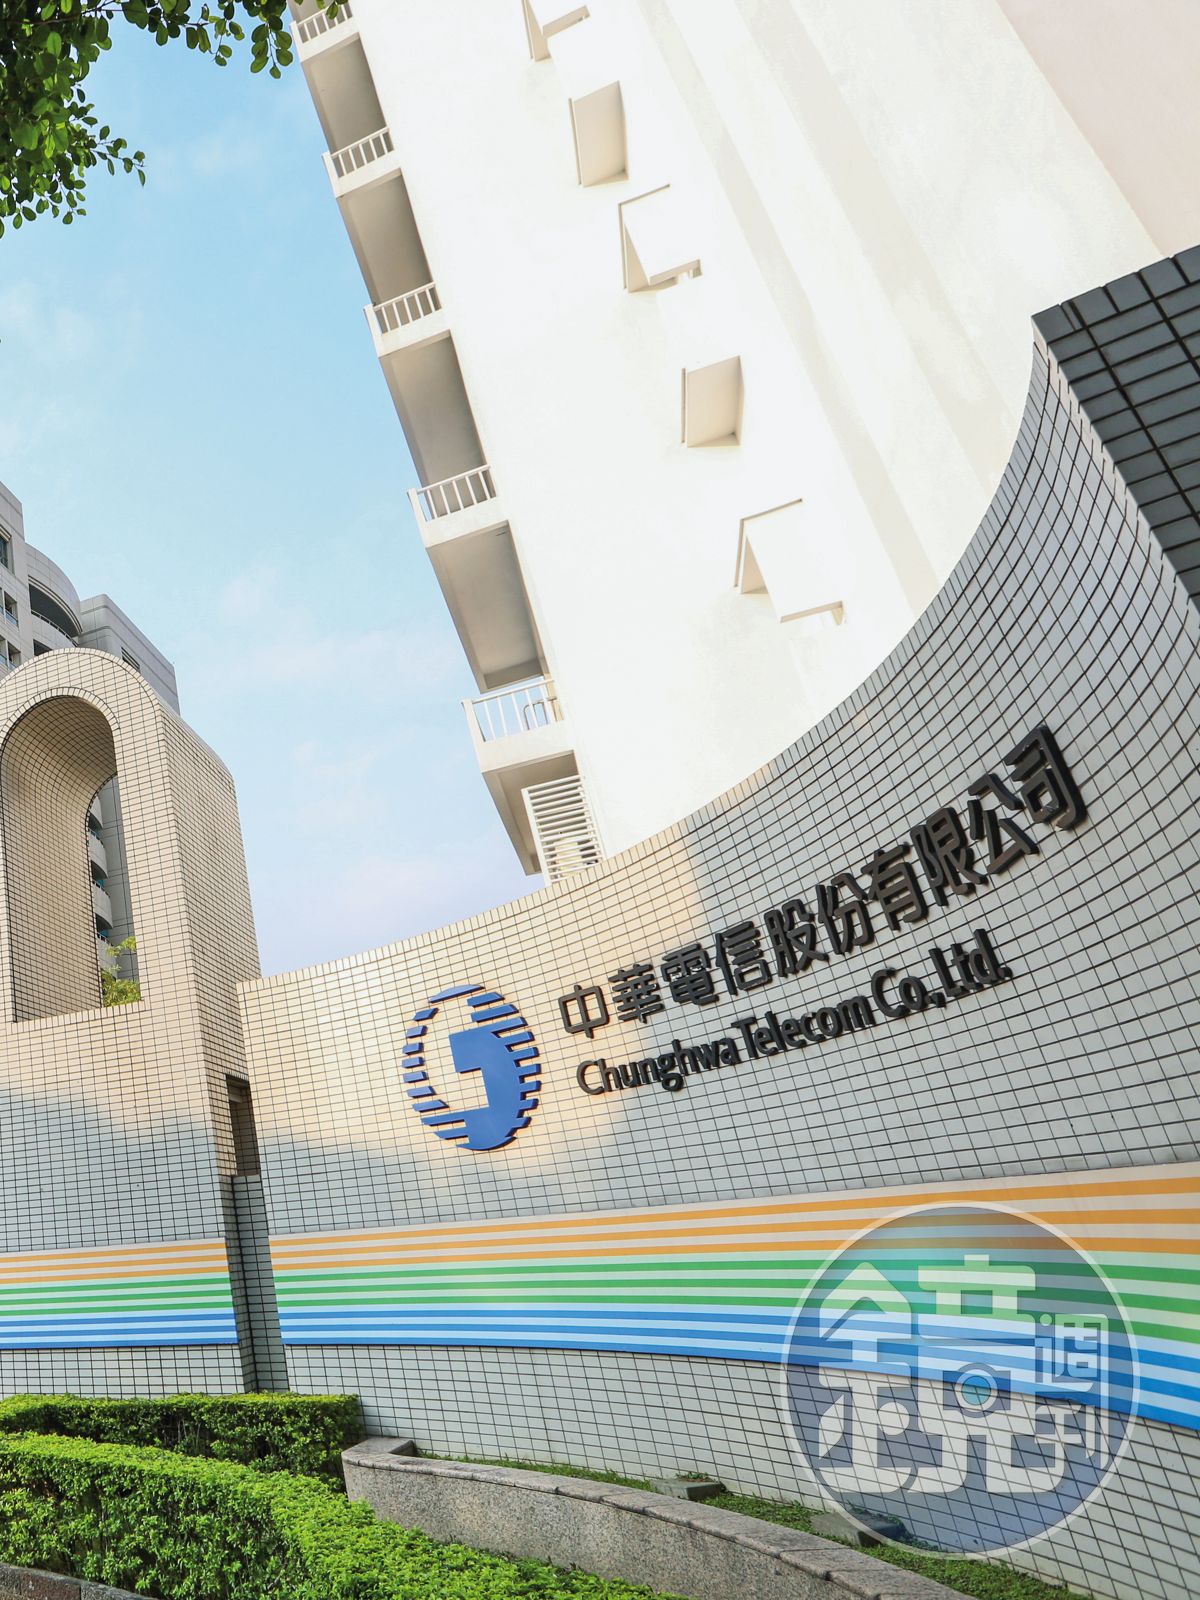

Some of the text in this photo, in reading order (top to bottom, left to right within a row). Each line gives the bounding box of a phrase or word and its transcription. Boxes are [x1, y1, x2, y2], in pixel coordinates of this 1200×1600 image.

[557, 724, 1089, 1039] 中華電信股份有限公司
[576, 928, 1014, 1093] Chunghwa Telecom Co.,Ltd.
